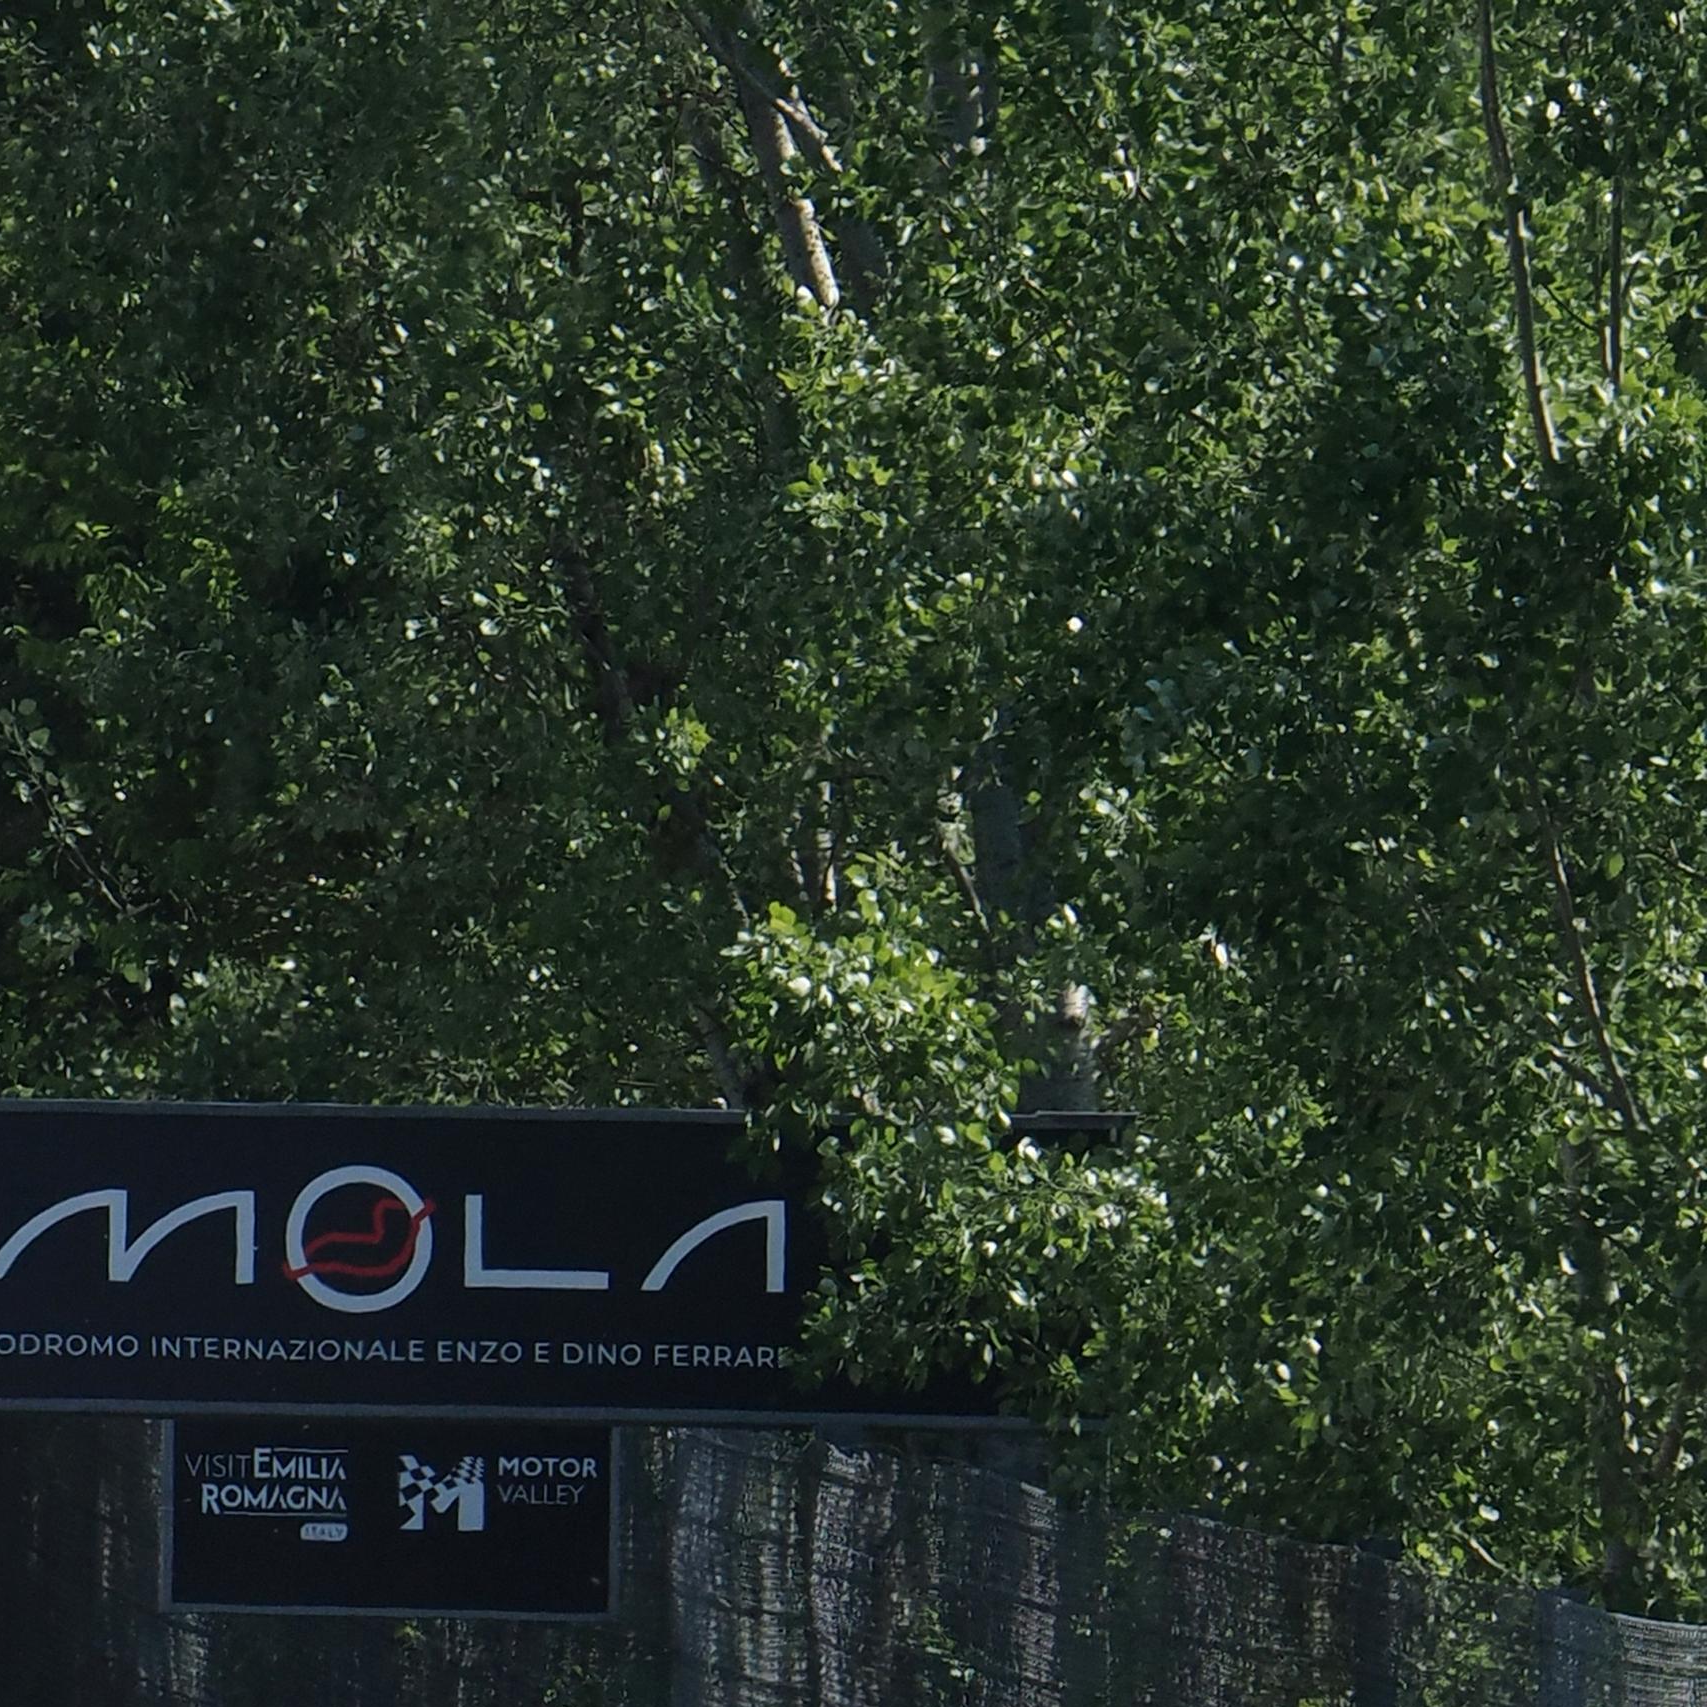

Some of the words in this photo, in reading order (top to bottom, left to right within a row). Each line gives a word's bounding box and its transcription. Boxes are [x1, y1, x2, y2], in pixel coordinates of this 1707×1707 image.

[151, 1335, 425, 1362] INTERNAZIONALE
[436, 1340, 523, 1365] ENZO
[533, 1341, 551, 1365] E
[562, 1342, 642, 1368] DINO
[497, 1456, 598, 1479] MOTOR
[200, 1482, 348, 1515] ROMAGNA
[496, 1484, 585, 1505] VALLEY
